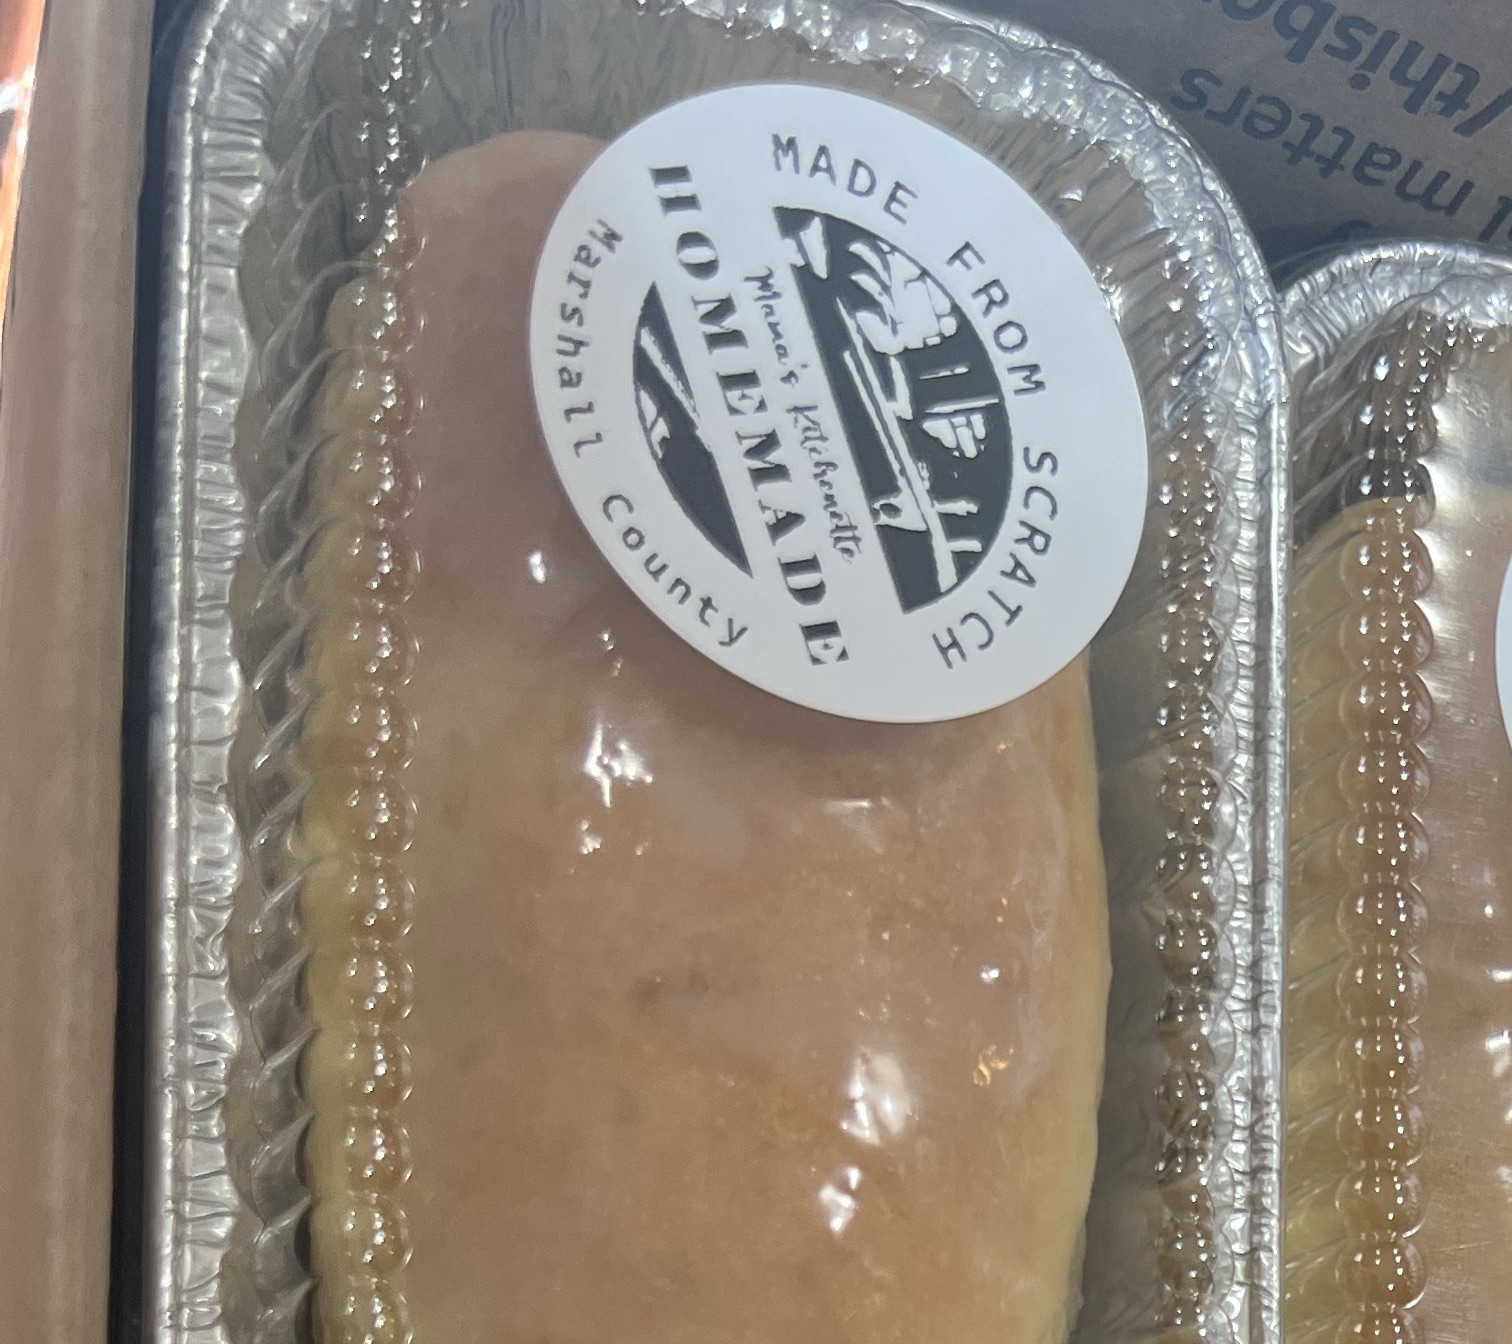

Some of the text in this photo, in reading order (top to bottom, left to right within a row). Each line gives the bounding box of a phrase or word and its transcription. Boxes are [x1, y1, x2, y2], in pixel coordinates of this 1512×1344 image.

[1170, 68, 1475, 217] matters
[556, 218, 750, 649] Marshall County
[648, 165, 850, 666] HOMEMADE
[771, 133, 1059, 669] MADE FROM SCRATCH
